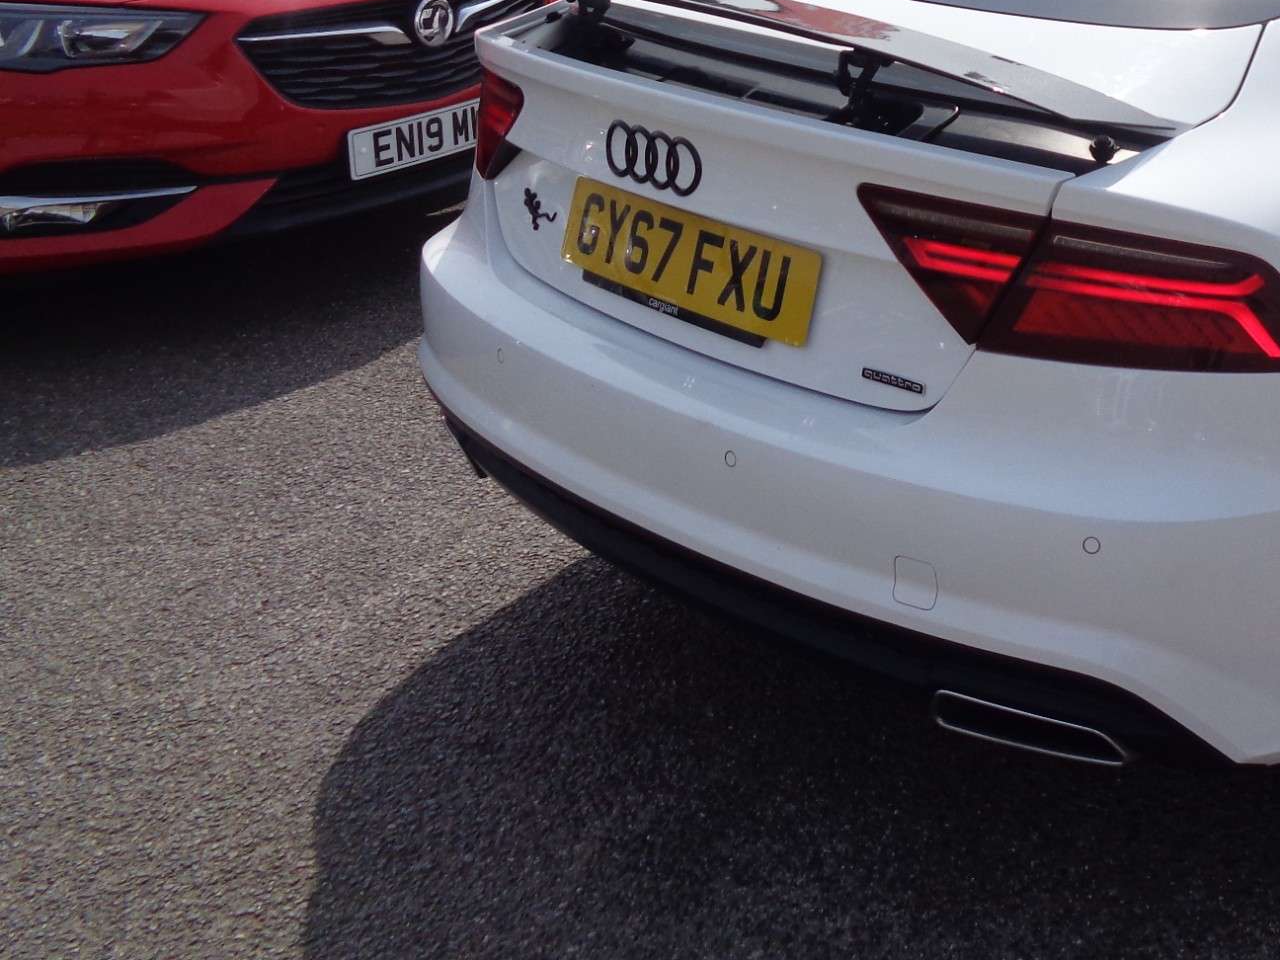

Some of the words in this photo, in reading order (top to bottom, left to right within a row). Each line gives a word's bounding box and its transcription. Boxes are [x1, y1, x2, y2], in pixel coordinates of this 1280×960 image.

[372, 116, 445, 168] EN19
[576, 192, 684, 283] GY67
[686, 230, 792, 322] FXU
[863, 368, 922, 393] quattro
